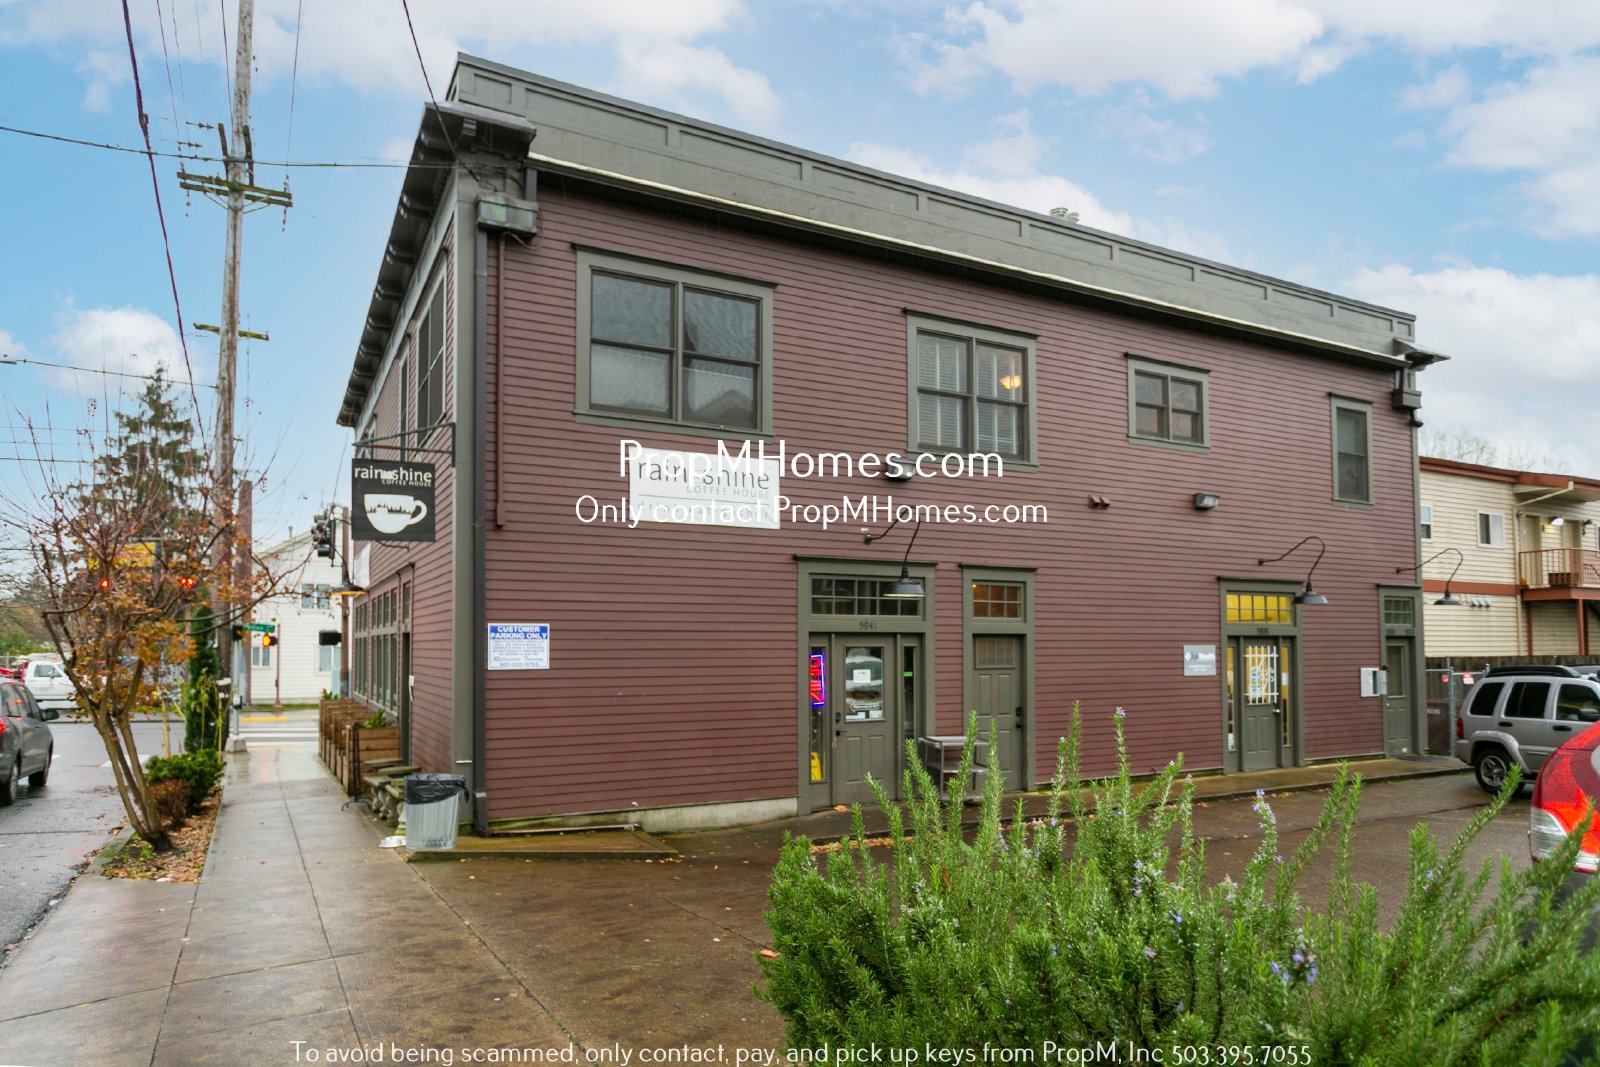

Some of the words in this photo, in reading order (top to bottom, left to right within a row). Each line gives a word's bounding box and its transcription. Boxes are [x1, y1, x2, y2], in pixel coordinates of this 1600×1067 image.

[354, 465, 383, 480] rain
[392, 466, 432, 483] shine
[733, 487, 769, 499] HOUSE
[497, 625, 540, 633] CUSTOMER
